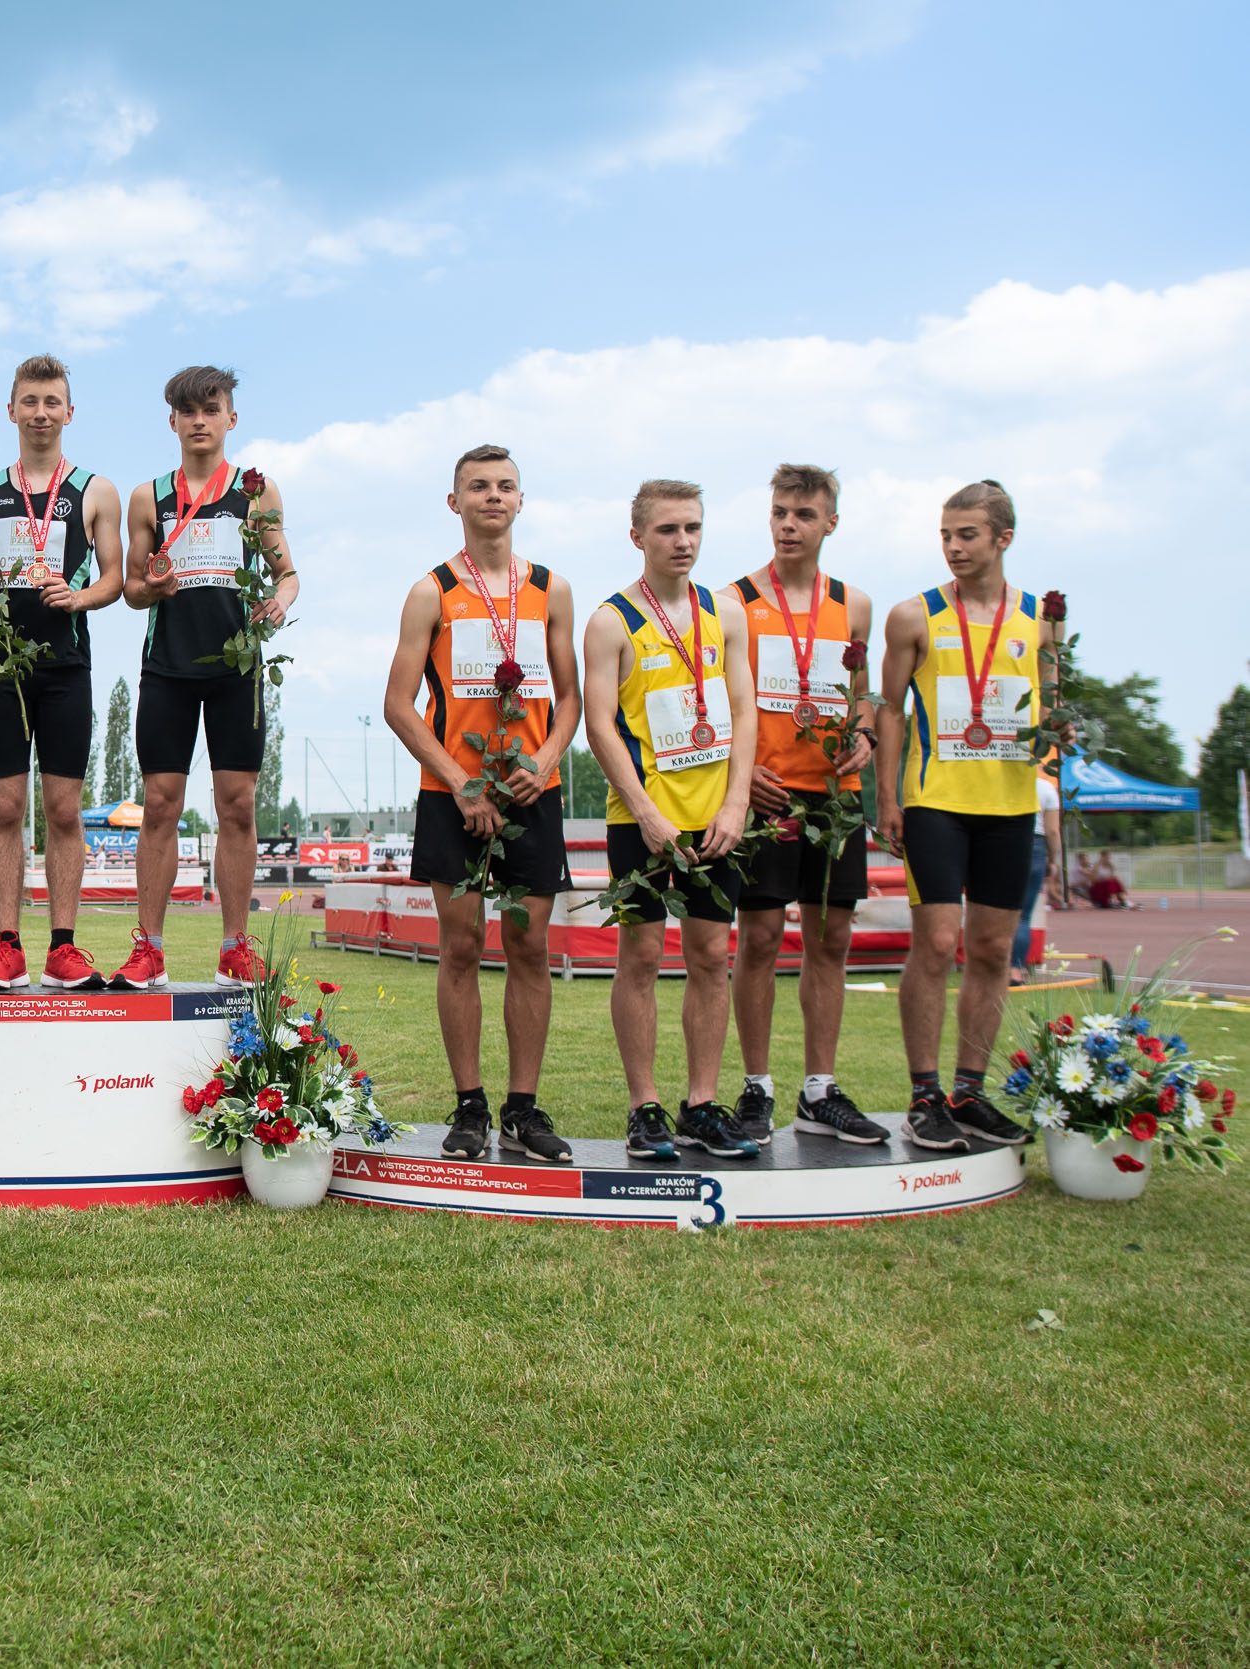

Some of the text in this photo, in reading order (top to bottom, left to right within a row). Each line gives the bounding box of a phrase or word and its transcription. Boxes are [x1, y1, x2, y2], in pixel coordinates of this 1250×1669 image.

[171, 557, 186, 570] 00
[179, 576, 231, 588] RAKÓW 2019
[456, 663, 483, 676] 100
[762, 677, 788, 691] 100
[519, 688, 534, 697] 019
[770, 702, 834, 714] KRAK 019
[656, 731, 684, 747] 100
[671, 750, 713, 767] KRAKÓW
[52, 1000, 86, 1008] POLSKI
[194, 1007, 206, 1015] 8-9
[207, 1006, 237, 1015] CZERWCA
[68, 1009, 127, 1017] SZTAFETACH
[93, 1073, 155, 1094] polanik
[333, 1155, 371, 1177] ZLA
[378, 1161, 483, 1177] MISTRZOSTWA POLSKI
[388, 1172, 457, 1185] WIELOBOJACH
[464, 1178, 527, 1190] SZTAFETACH
[655, 1176, 695, 1187] KRAKÓW
[913, 1169, 963, 1192] polanik
[628, 1187, 672, 1196] CZERWCA
[674, 1187, 695, 1196] 2019
[691, 1177, 725, 1228] 3
